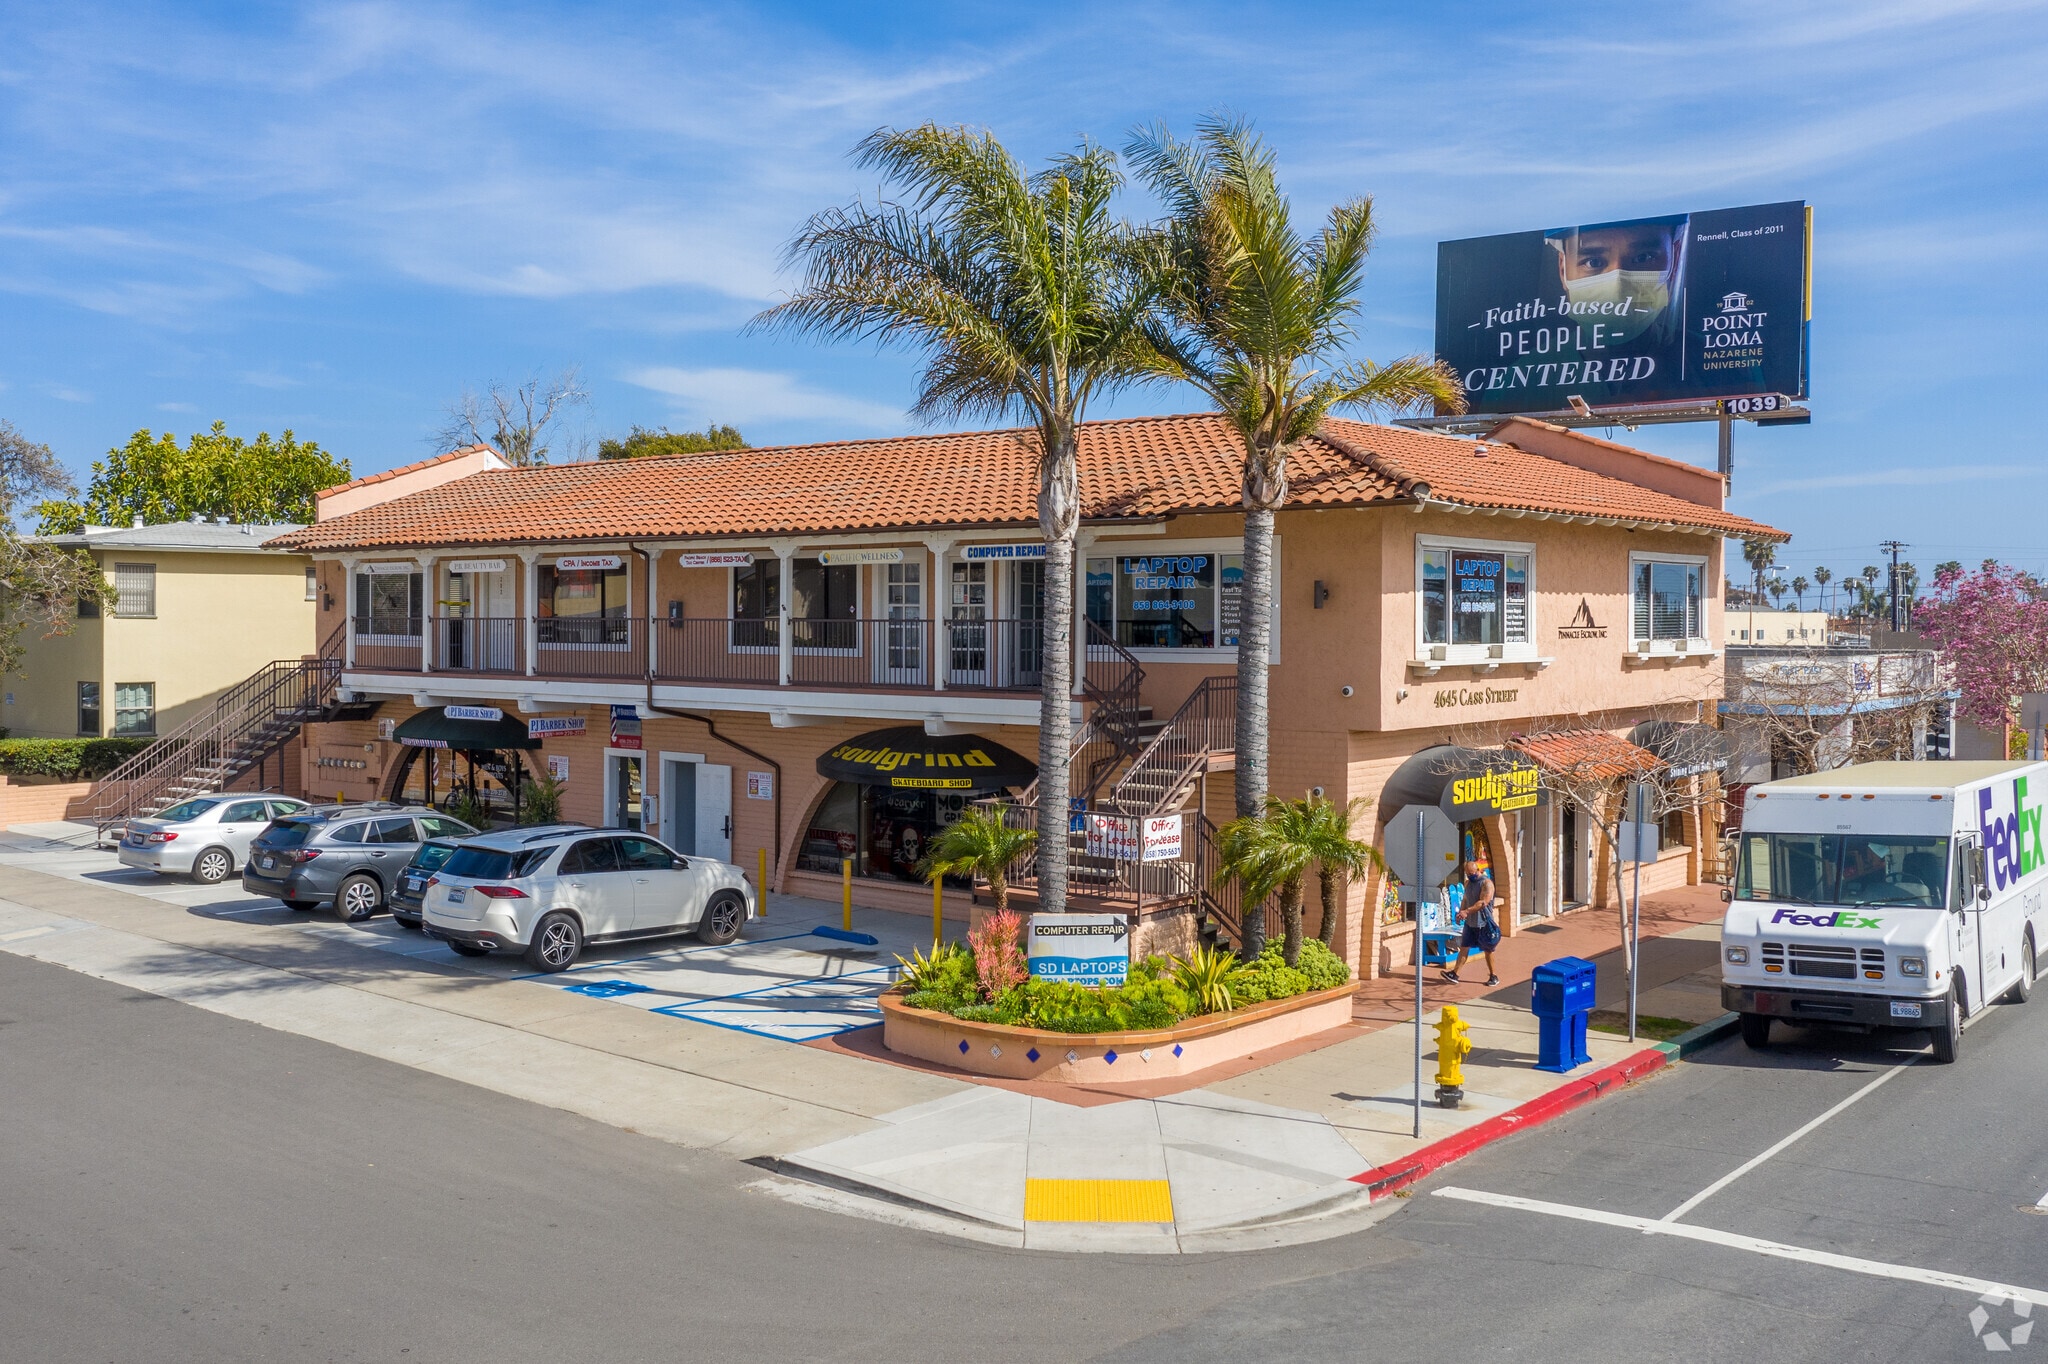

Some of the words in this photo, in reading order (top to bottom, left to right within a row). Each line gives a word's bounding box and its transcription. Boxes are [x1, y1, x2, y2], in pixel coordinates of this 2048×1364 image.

[1697, 232, 1729, 242] Rennell,
[1731, 230, 1752, 238] Class
[1754, 227, 1764, 236] of
[1764, 225, 1784, 234] 2011
[1702, 312, 1767, 332] POINT
[1704, 331, 1763, 349] LOMA
[1703, 348, 1763, 359] NAZARENE
[1703, 359, 1763, 370] UNIVERSITY
[1464, 356, 1656, 392] CENTERED
[1727, 396, 1777, 414] 1039
[967, 546, 1014, 558] COMPUTER
[464, 562, 487, 570] BEAUTY
[602, 558, 613, 566] TAX
[1123, 556, 1207, 575] LAPTOP
[1455, 559, 1501, 576] LAPTOP
[1134, 576, 1196, 590] REPAIR
[1461, 578, 1495, 592] REPAIR
[1132, 600, 1150, 611] 858
[1152, 600, 1195, 610] 864-3108
[1558, 630, 1580, 640] PINNACLE
[1433, 689, 1457, 708] 4645
[1459, 688, 1484, 707] CASS
[1485, 687, 1519, 704] STREET
[450, 707, 457, 717] PJ
[457, 708, 480, 718] BARBER
[480, 708, 495, 719] SHOP
[531, 720, 539, 731] PJ
[540, 719, 567, 730] BARBER
[567, 718, 585, 729] SHOP
[831, 745, 996, 771] soulgrind
[892, 778, 944, 787] SKATEBOARD
[1452, 760, 1539, 809] soulgrind
[1095, 819, 1128, 832] Office
[1088, 831, 1104, 843] For
[1107, 833, 1137, 847] Lease
[1158, 834, 1180, 845] Lease
[1978, 775, 2046, 891] FedEx
[1157, 847, 1180, 857] 750-5631
[1770, 909, 1885, 929] FedEx
[1036, 926, 1089, 935] COMPUTER
[1091, 926, 1125, 934] REPAIR
[1038, 962, 1057, 974] SD
[1062, 961, 1127, 974] LAPTOPS
